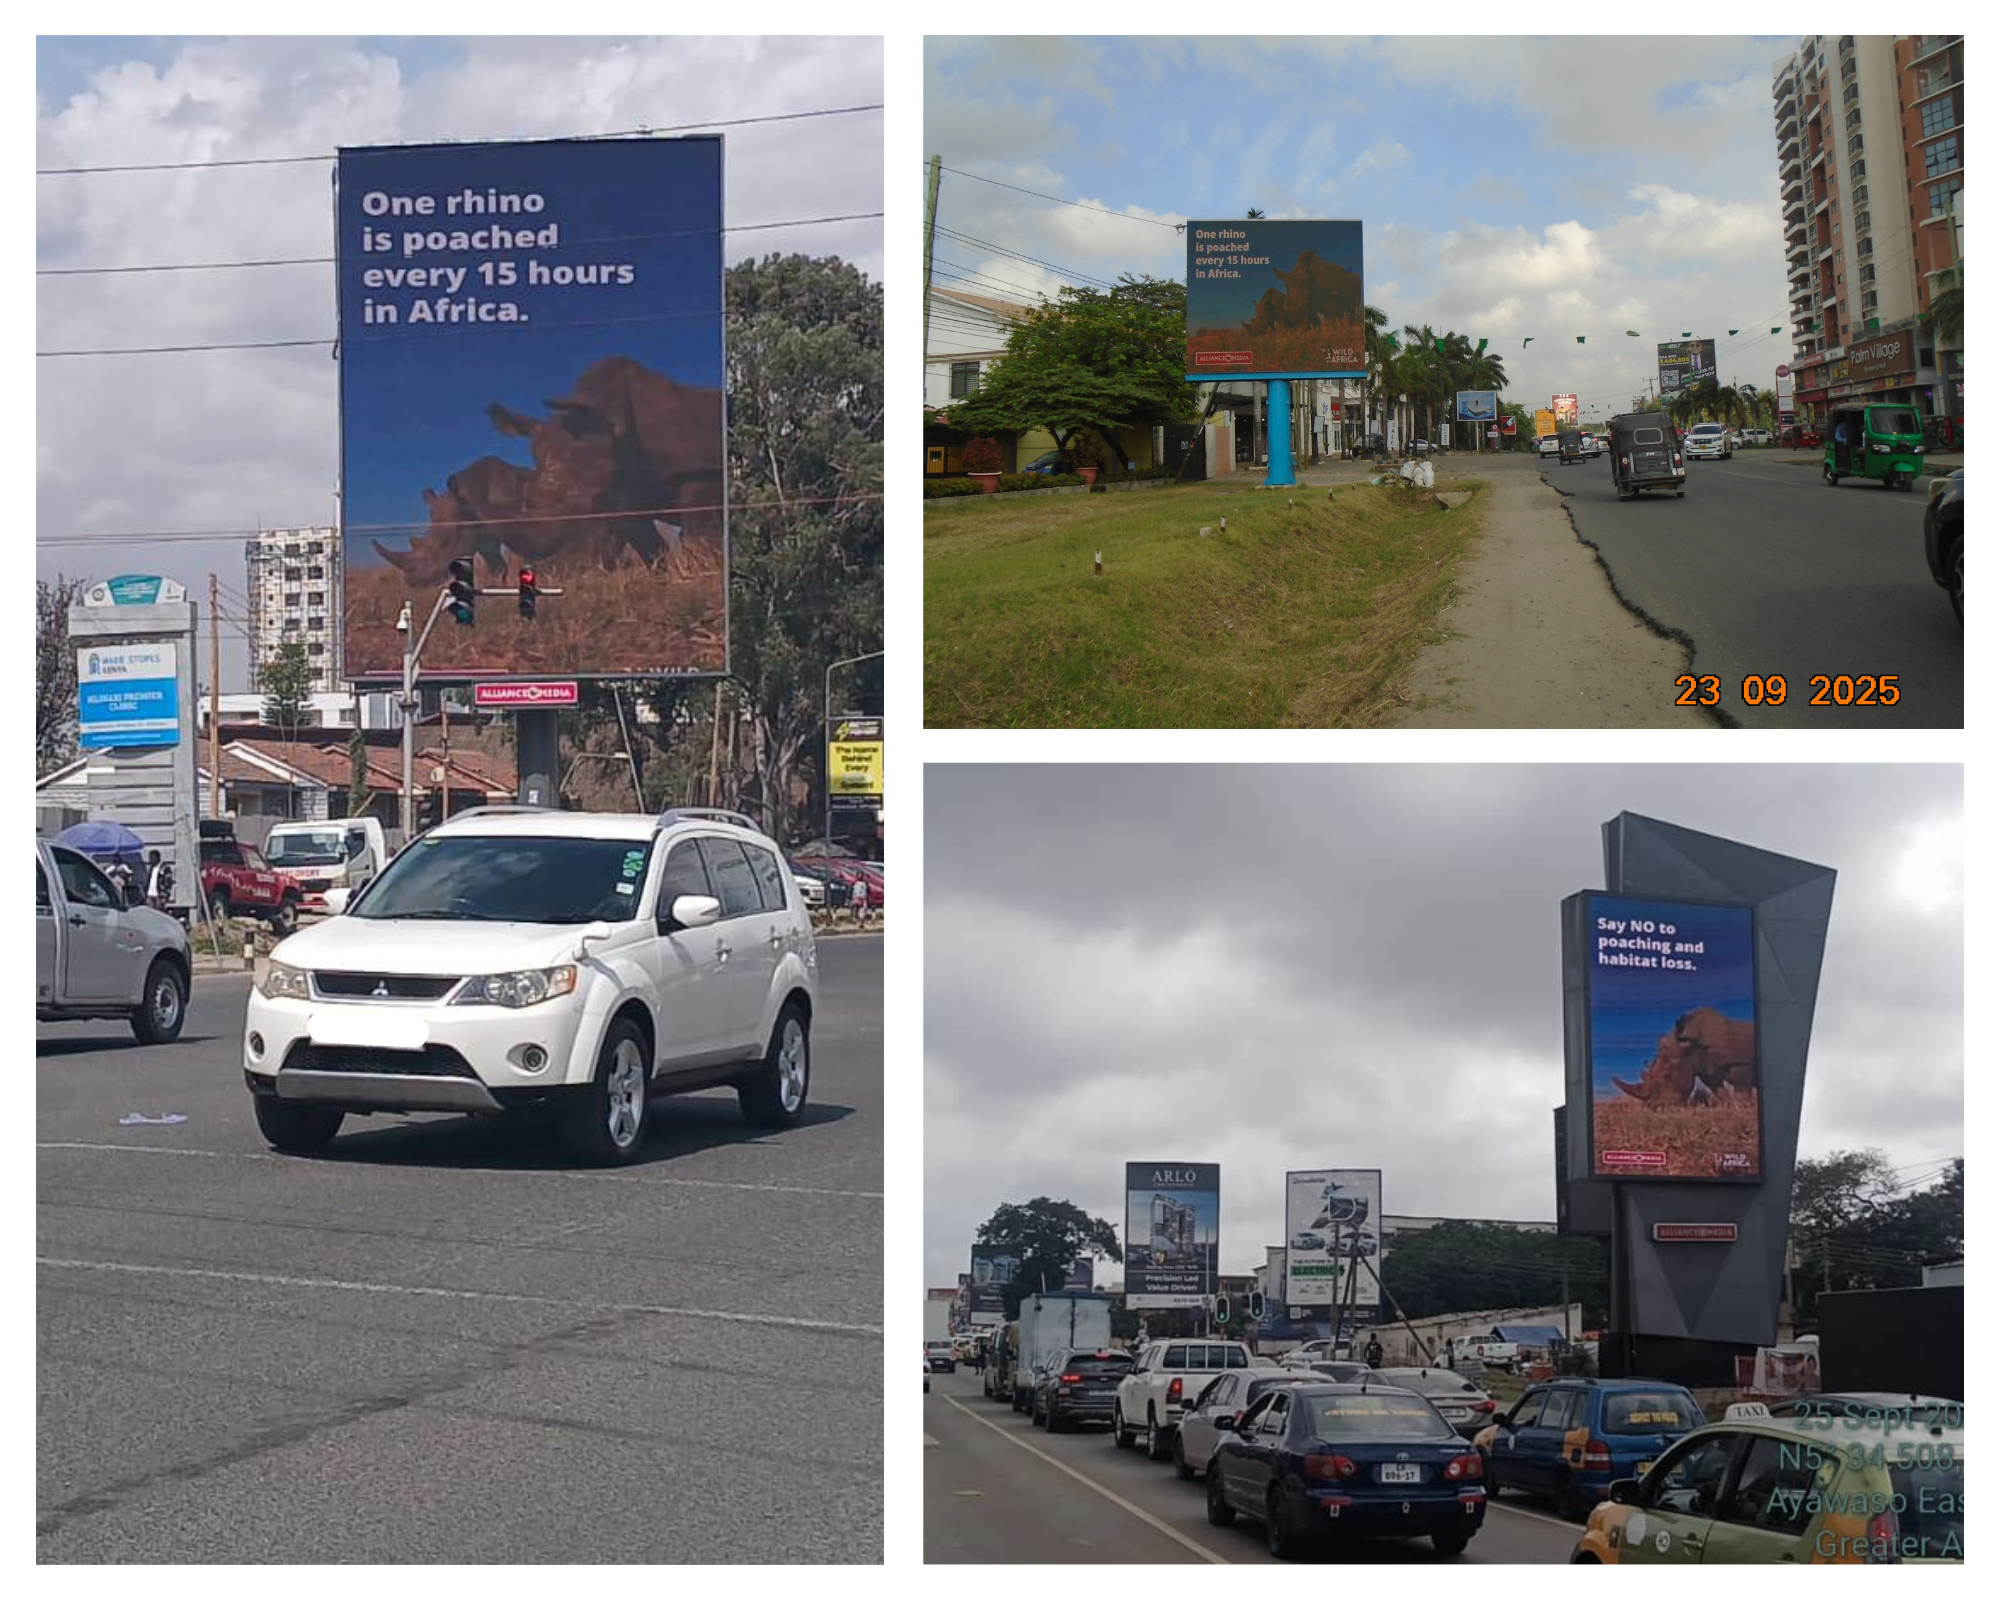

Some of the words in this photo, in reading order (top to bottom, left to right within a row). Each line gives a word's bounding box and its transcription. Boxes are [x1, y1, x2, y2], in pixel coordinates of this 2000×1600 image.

[362, 190, 436, 216] One
[446, 188, 545, 215] rhino
[362, 226, 393, 252] is
[403, 222, 559, 258] poached
[1195, 229, 1217, 239] One
[1218, 228, 1246, 239] rhino
[1195, 242, 1205, 252] is
[1206, 242, 1250, 254] poached
[1195, 256, 1225, 268] every
[1226, 255, 1239, 265] 15
[1240, 255, 1270, 265] hours
[363, 265, 467, 293] every
[478, 261, 517, 286] 15
[528, 260, 635, 286] hours
[1195, 268, 1206, 278] in
[1207, 268, 1242, 278] Africa.
[363, 298, 398, 324] in
[408, 297, 529, 324] Africa.
[1332, 348, 1354, 356] WILD
[1850, 348, 1870, 365] Palm
[1870, 341, 1901, 360] Village
[1331, 355, 1358, 363] AFRICA
[480, 687, 529, 699] ALLIANCE
[539, 687, 571, 698] MEDIA
[1597, 917, 1626, 934] Say
[1630, 919, 1655, 933] NO
[1659, 922, 1676, 935] to
[1598, 936, 1672, 955] poaching
[1674, 941, 1704, 954] and
[1598, 951, 1659, 968] habitat
[1661, 956, 1697, 971] loss.
[1723, 1153, 1746, 1161] WILD
[1145, 1273, 1182, 1282] Precision
[1184, 1274, 1199, 1282] Led
[1146, 1283, 1169, 1291] Value
[1171, 1283, 1197, 1292] Driven
[1734, 1404, 1765, 1418] TAXI
